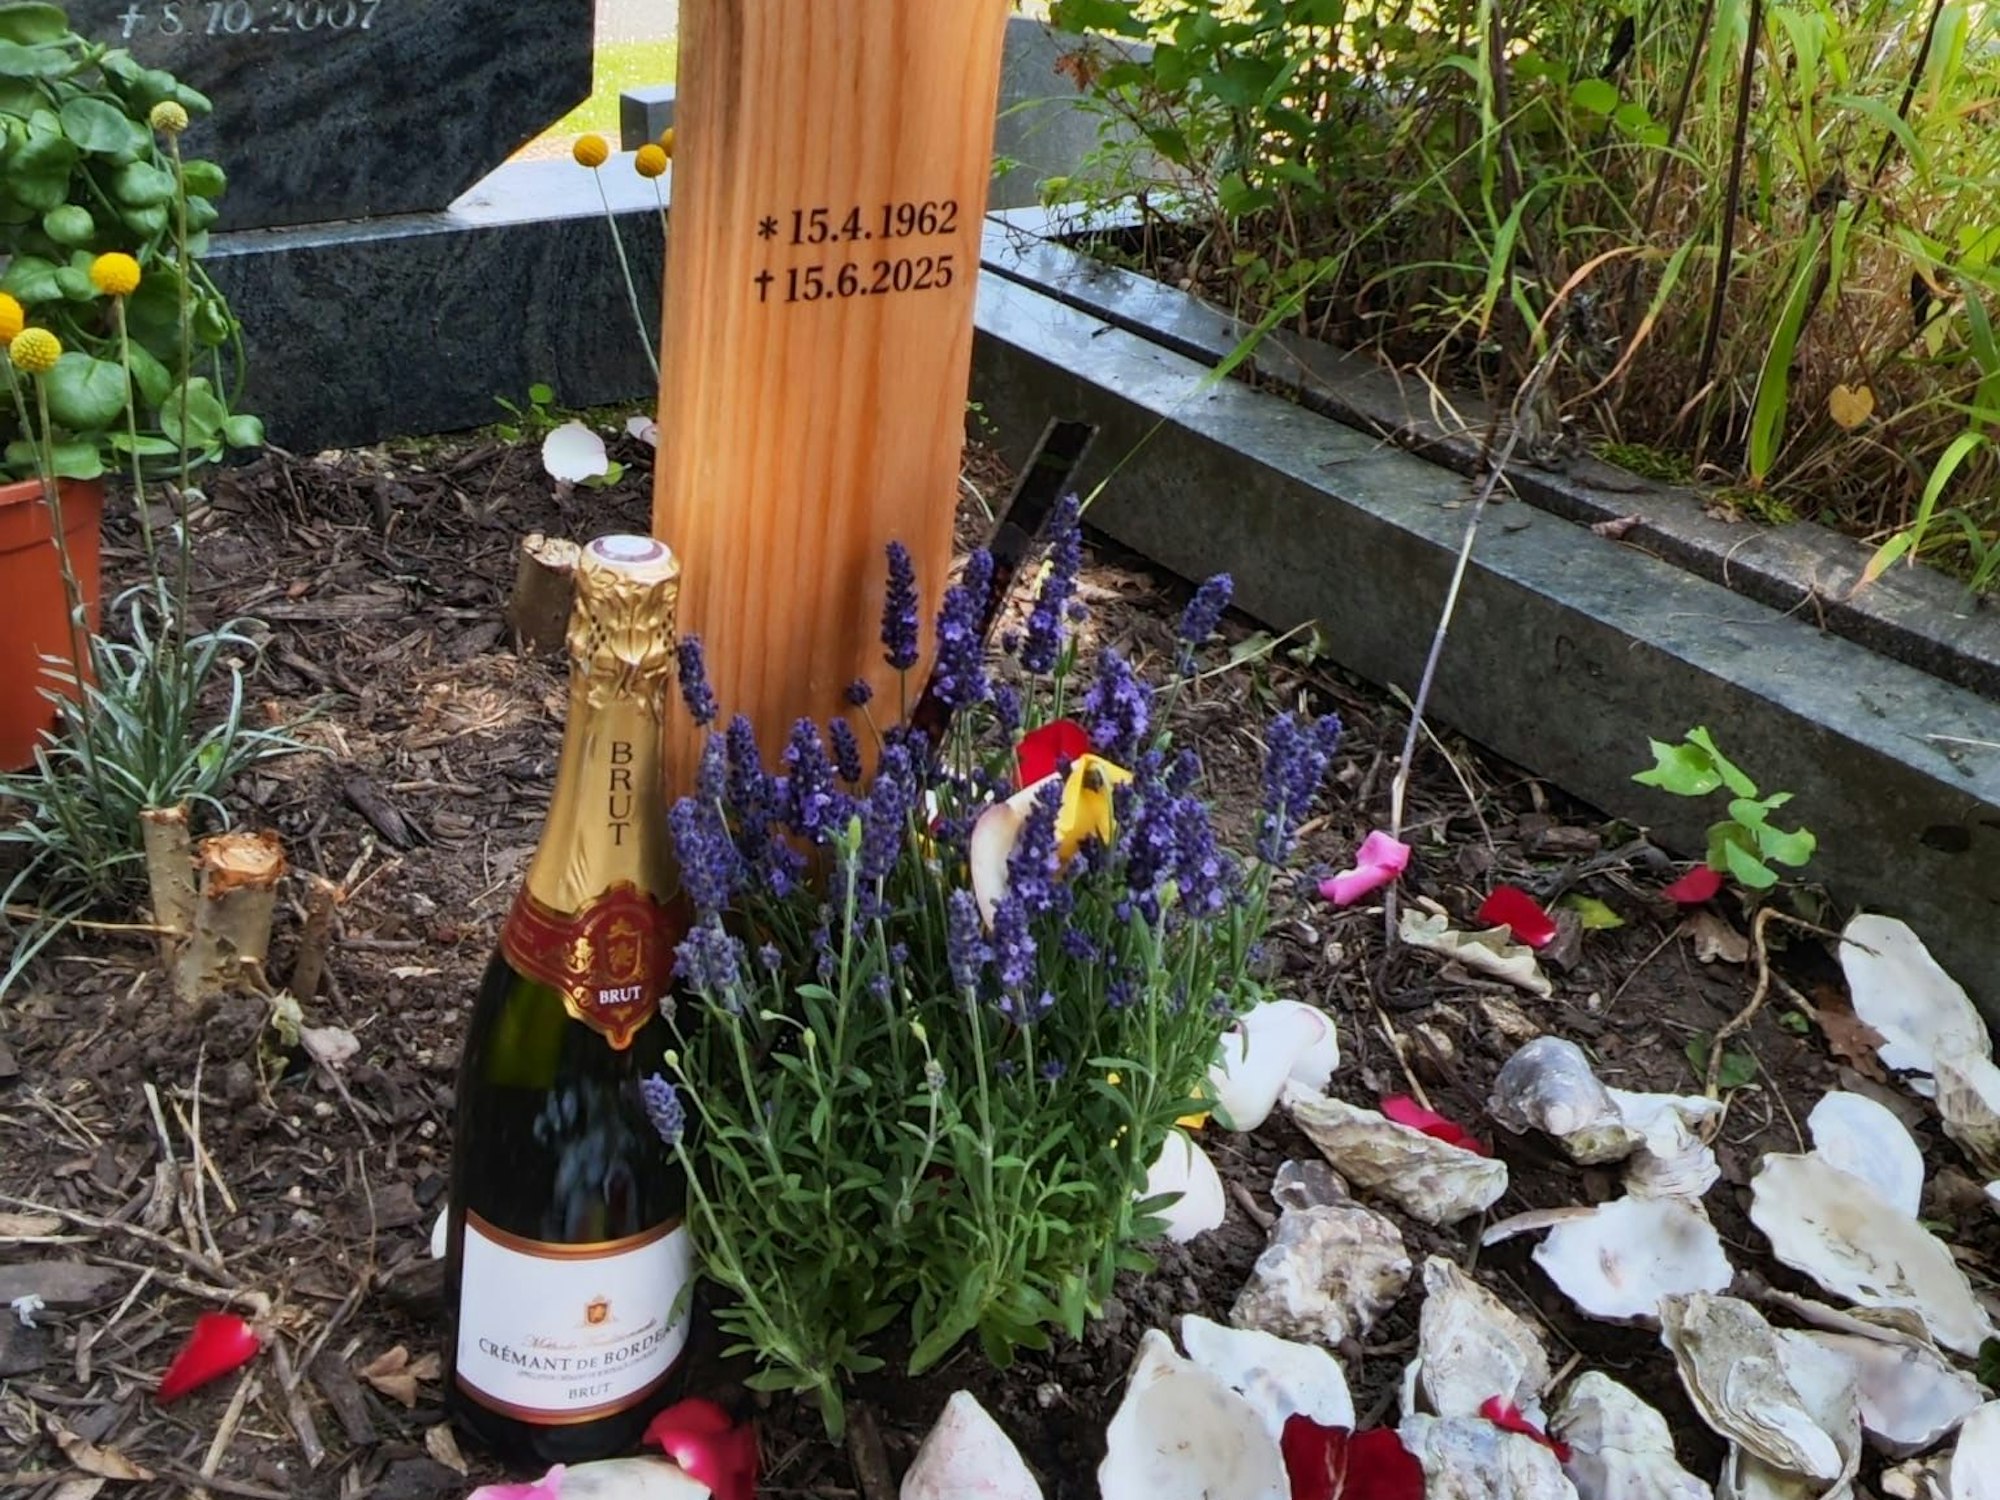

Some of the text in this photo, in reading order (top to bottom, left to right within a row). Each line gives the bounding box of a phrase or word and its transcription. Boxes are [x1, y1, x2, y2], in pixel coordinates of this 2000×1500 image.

[789, 200, 959, 246] 15.4.1962
[785, 255, 954, 303] 15.6.2025
[607, 740, 633, 846] BRUT
[599, 985, 643, 1005] BRUT
[478, 1336, 573, 1372] CRÉMANT
[576, 1358, 598, 1371] DE
[567, 1382, 614, 1400] BRUT
